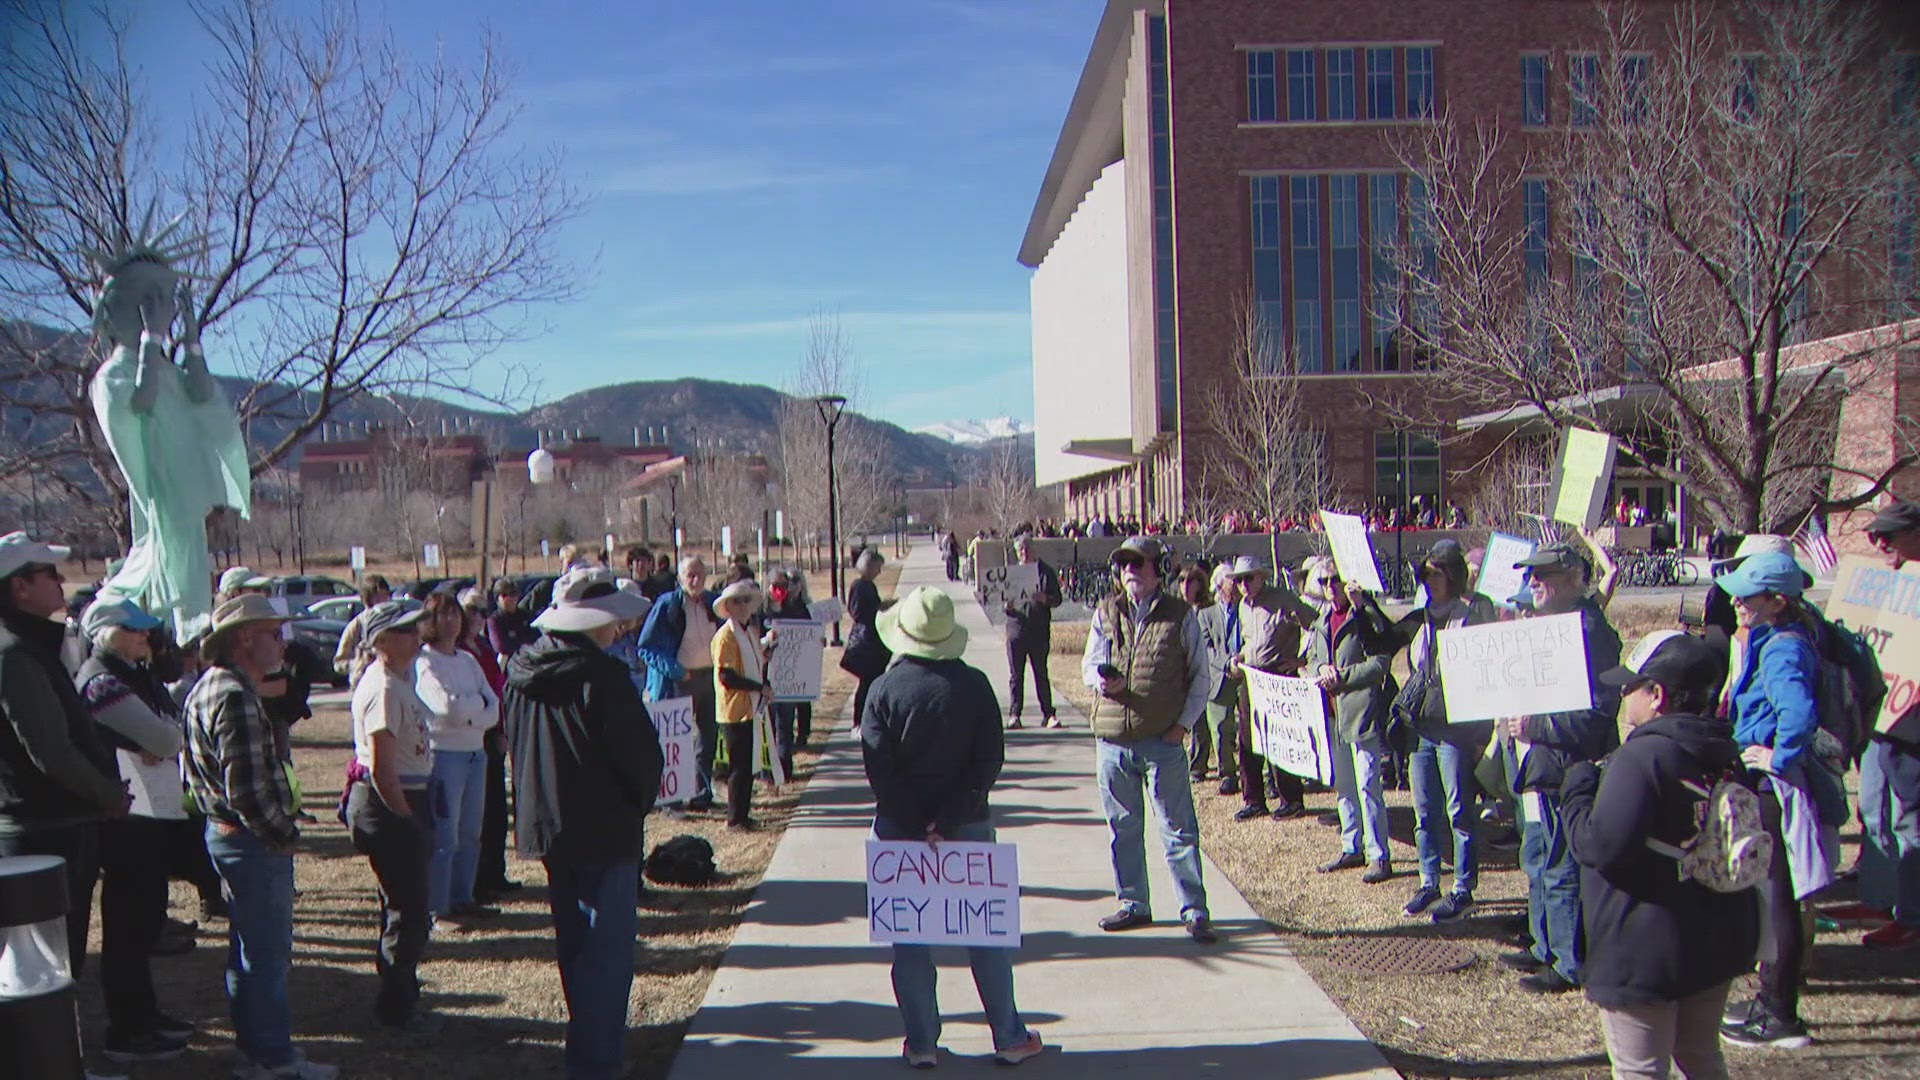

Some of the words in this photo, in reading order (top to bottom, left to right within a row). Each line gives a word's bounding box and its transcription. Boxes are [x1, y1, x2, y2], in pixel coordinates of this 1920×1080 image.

[986, 567, 1007, 582] CU
[1472, 650, 1558, 690] ICE
[665, 742, 680, 767] IR
[872, 850, 1008, 888] CANCEL
[871, 896, 930, 934] KEY
[944, 898, 1007, 935] LIME
